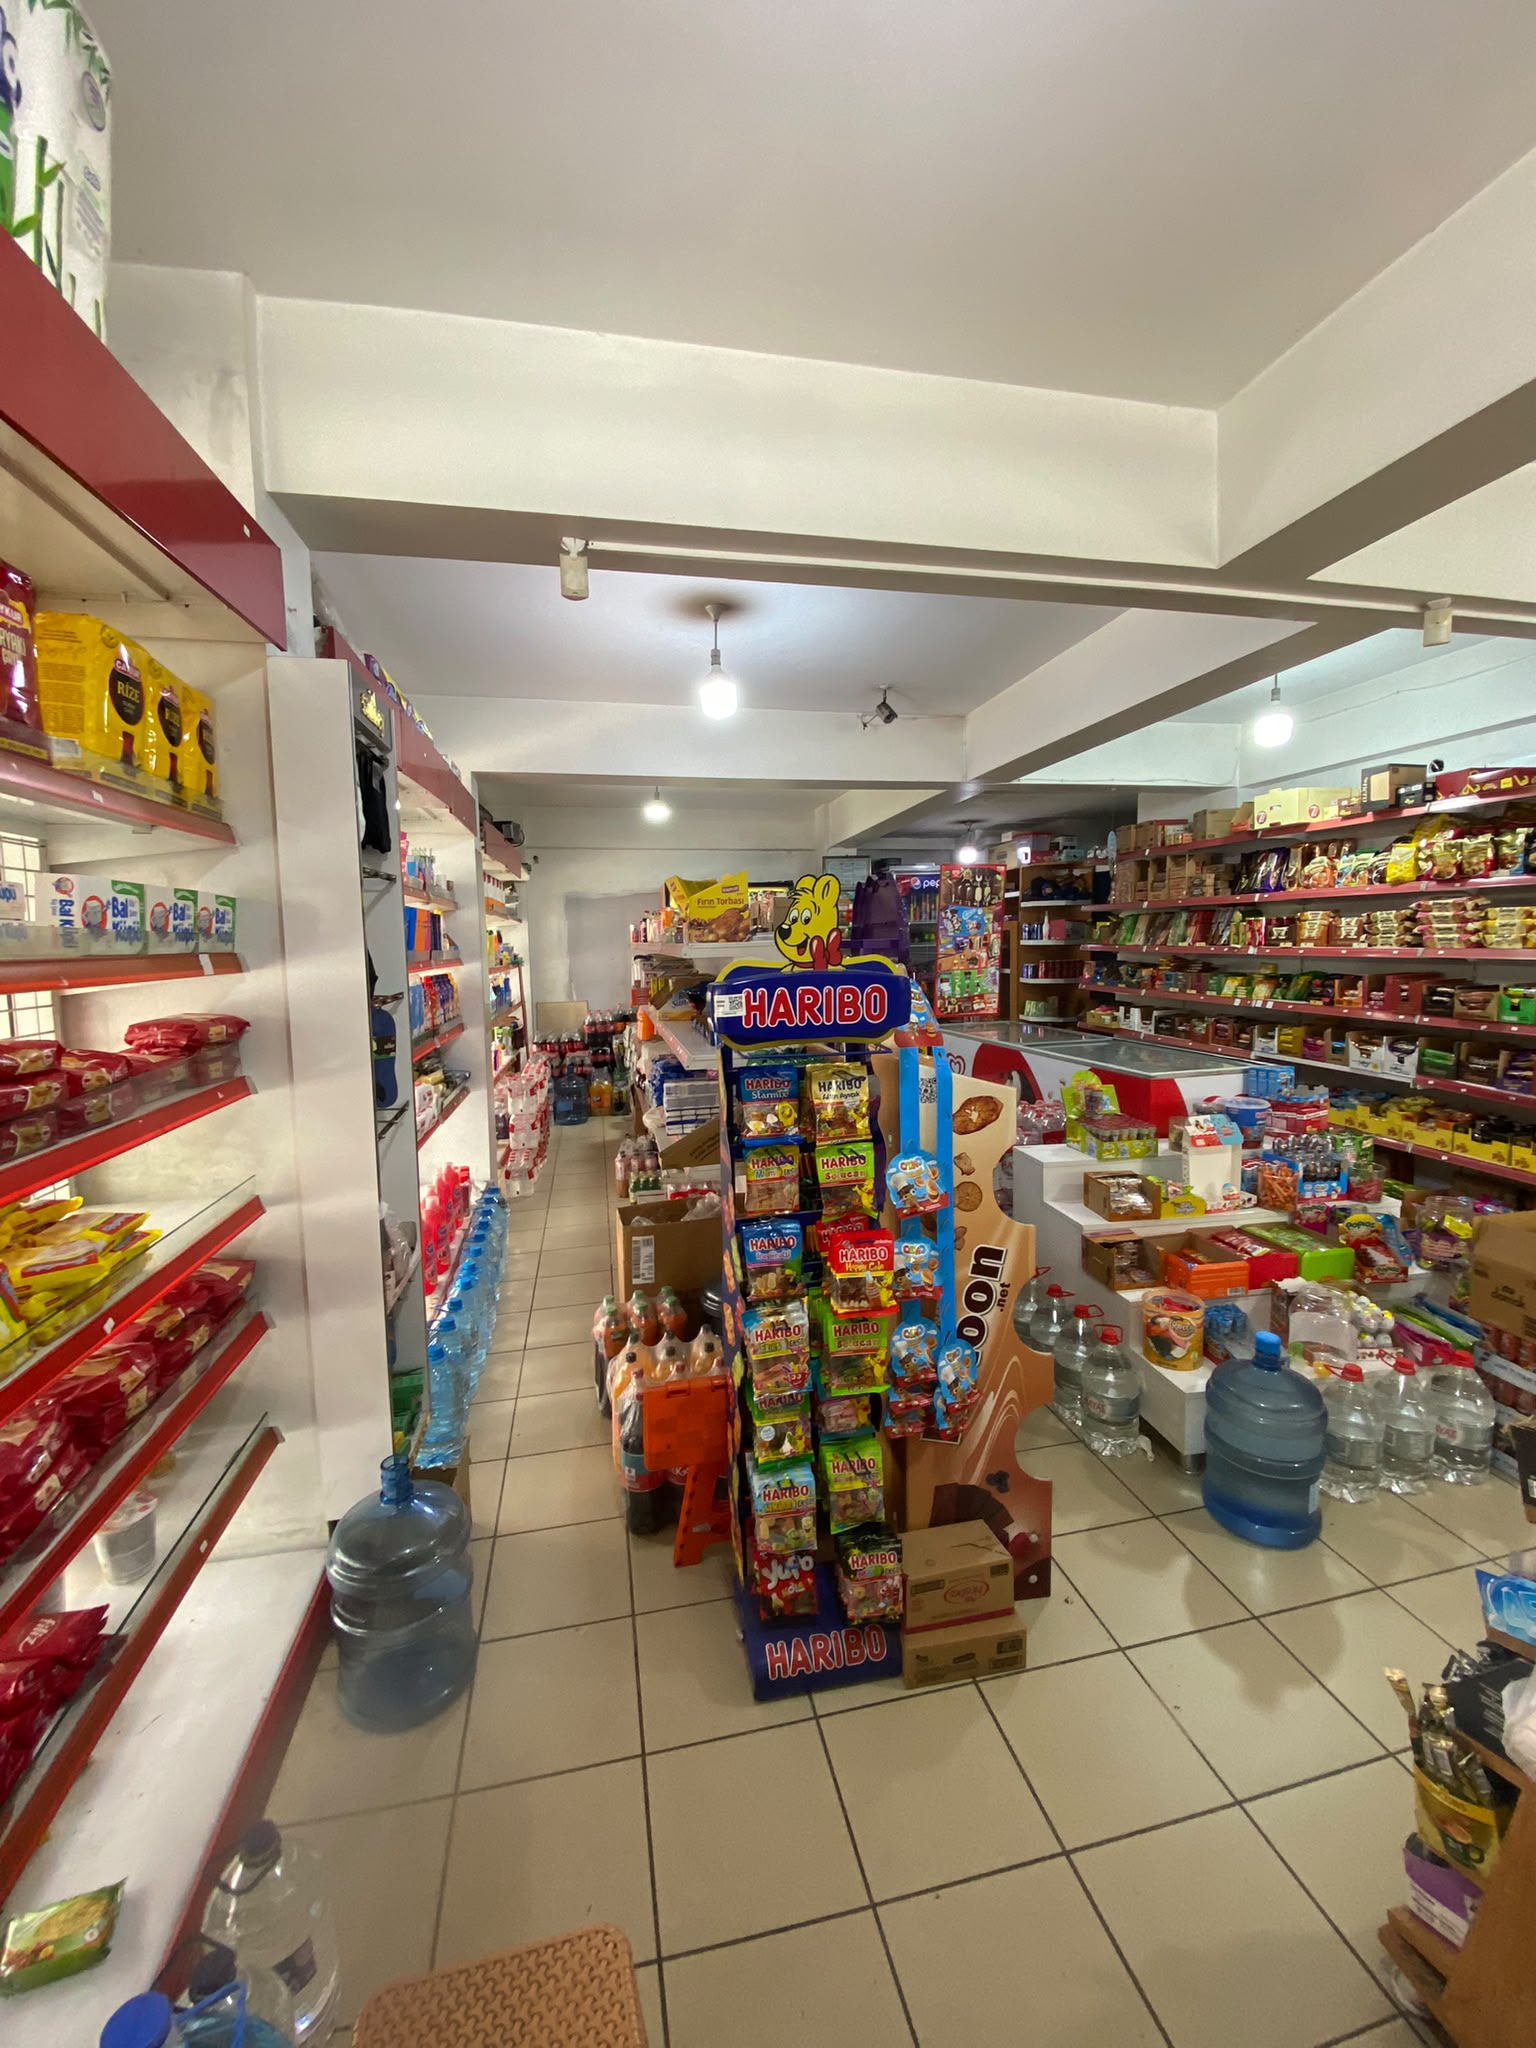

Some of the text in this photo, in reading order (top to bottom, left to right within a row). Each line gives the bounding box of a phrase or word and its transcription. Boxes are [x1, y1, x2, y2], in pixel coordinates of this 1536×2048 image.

[923, 878, 940, 889] pep
[112, 896, 128, 918] Bal
[743, 985, 888, 1028] HARIBO
[821, 1155, 867, 1170] HARIBO
[840, 1247, 889, 1263] HARIBO
[755, 1324, 801, 1343] HARIBO
[833, 1322, 880, 1338] HARIBO
[763, 1485, 809, 1502] HARIBO
[850, 1551, 898, 1570] HARIBO
[765, 1624, 887, 1681] HARIBO
